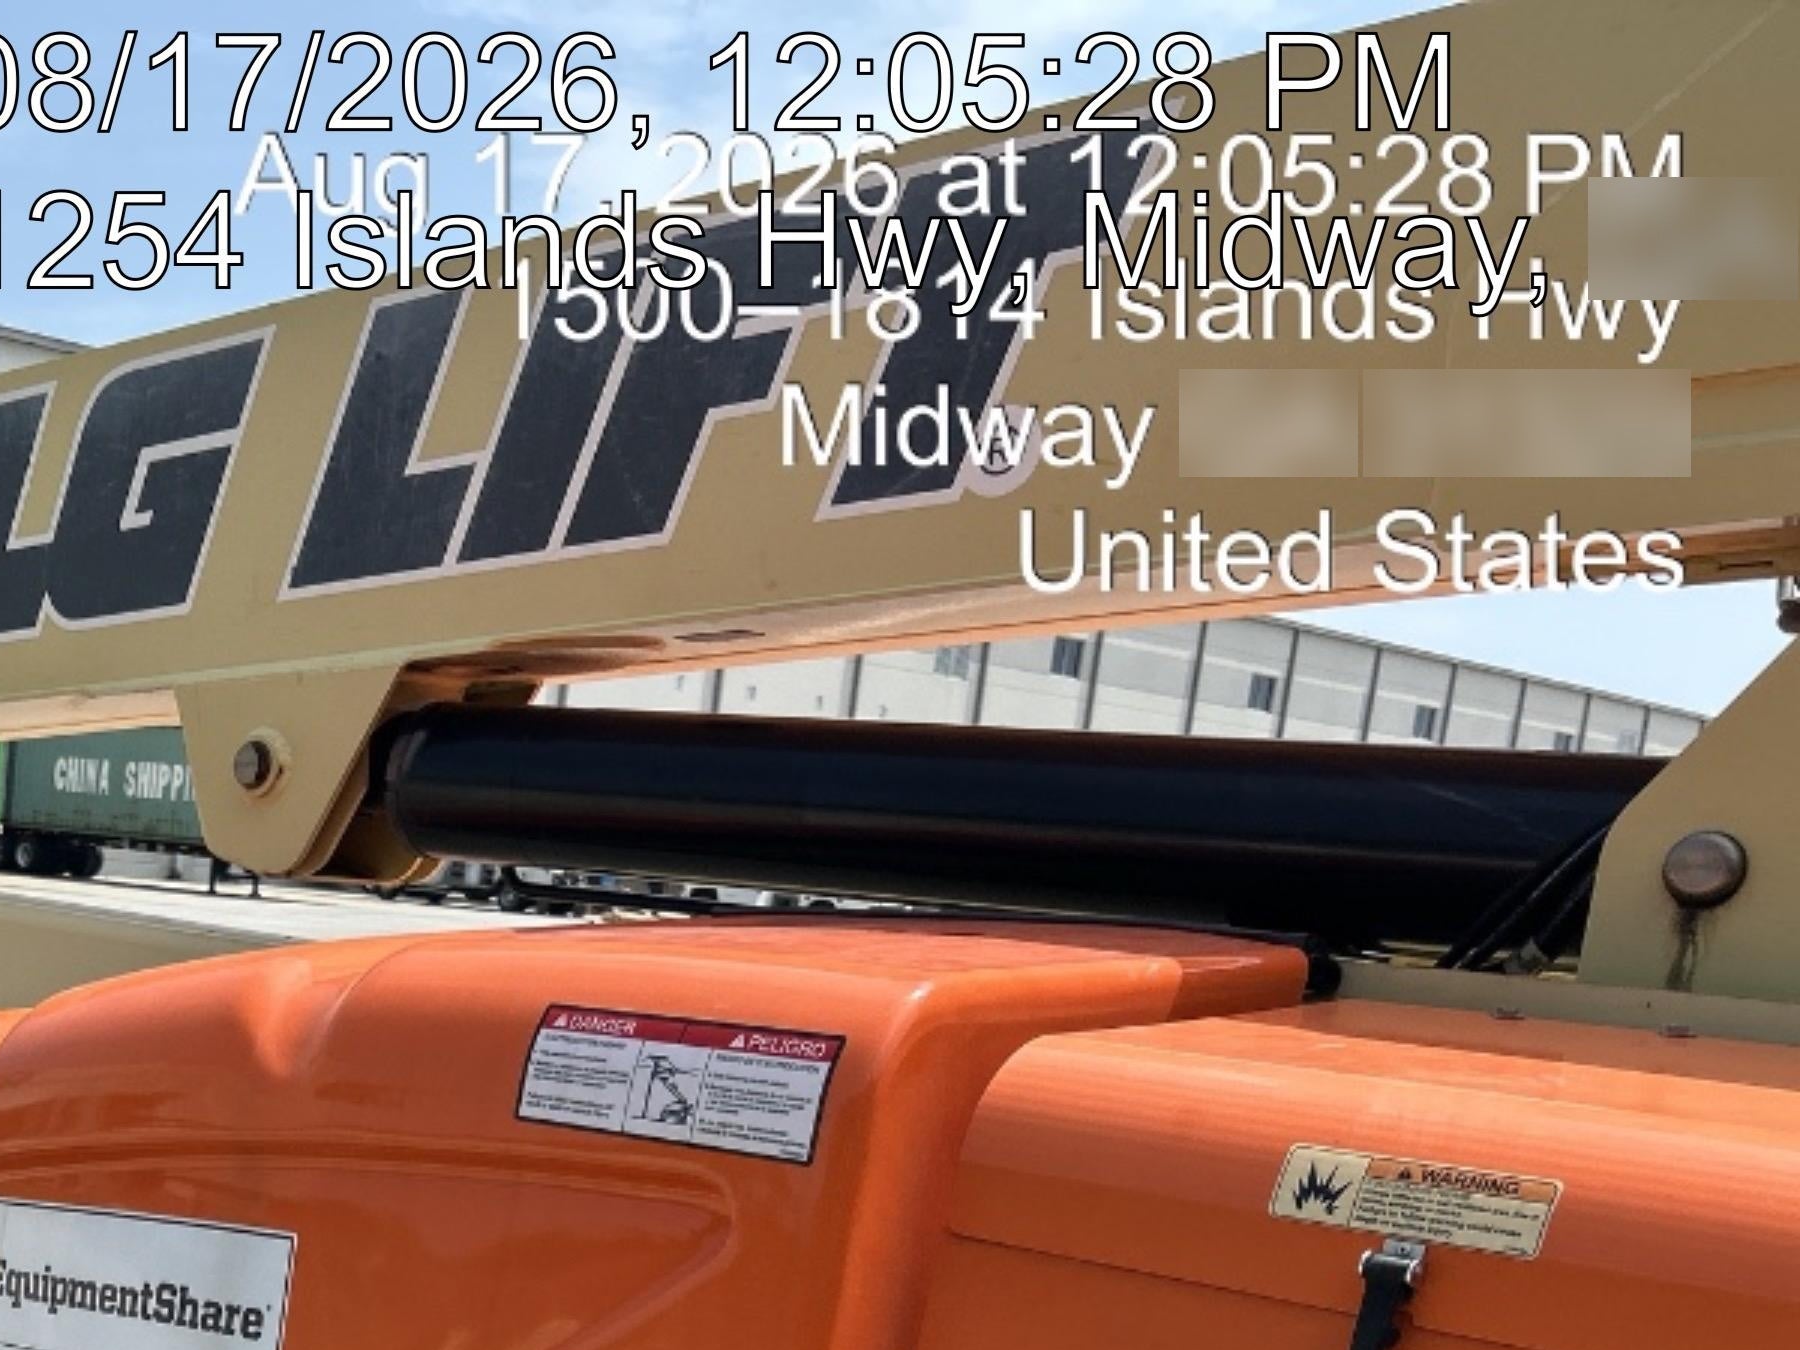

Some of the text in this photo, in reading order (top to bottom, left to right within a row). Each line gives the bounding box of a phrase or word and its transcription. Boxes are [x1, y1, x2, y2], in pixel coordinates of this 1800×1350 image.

[283, 98, 1184, 600] LIFT
[53, 755, 196, 802] CHINA SHIPPI
[568, 1014, 638, 1037] DANGER
[747, 1034, 828, 1058] PELIGRO
[1420, 1167, 1520, 1196] WARNING
